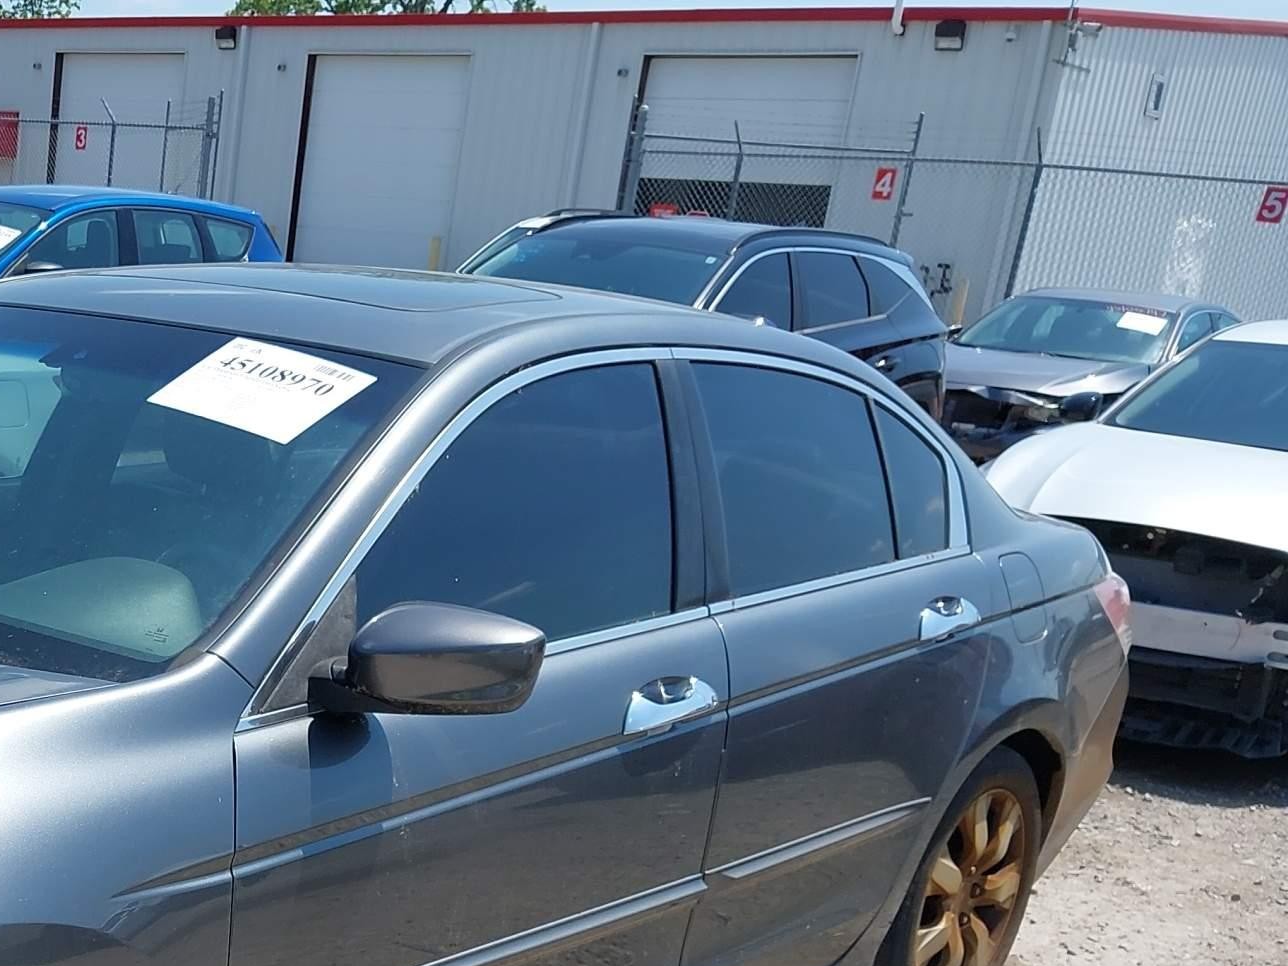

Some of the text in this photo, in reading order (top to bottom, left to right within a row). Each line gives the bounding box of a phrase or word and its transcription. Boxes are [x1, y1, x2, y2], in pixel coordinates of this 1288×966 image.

[77, 129, 86, 148] 3
[874, 171, 893, 197] 4
[1261, 191, 1287, 219] 5
[219, 355, 336, 397] 45108970
